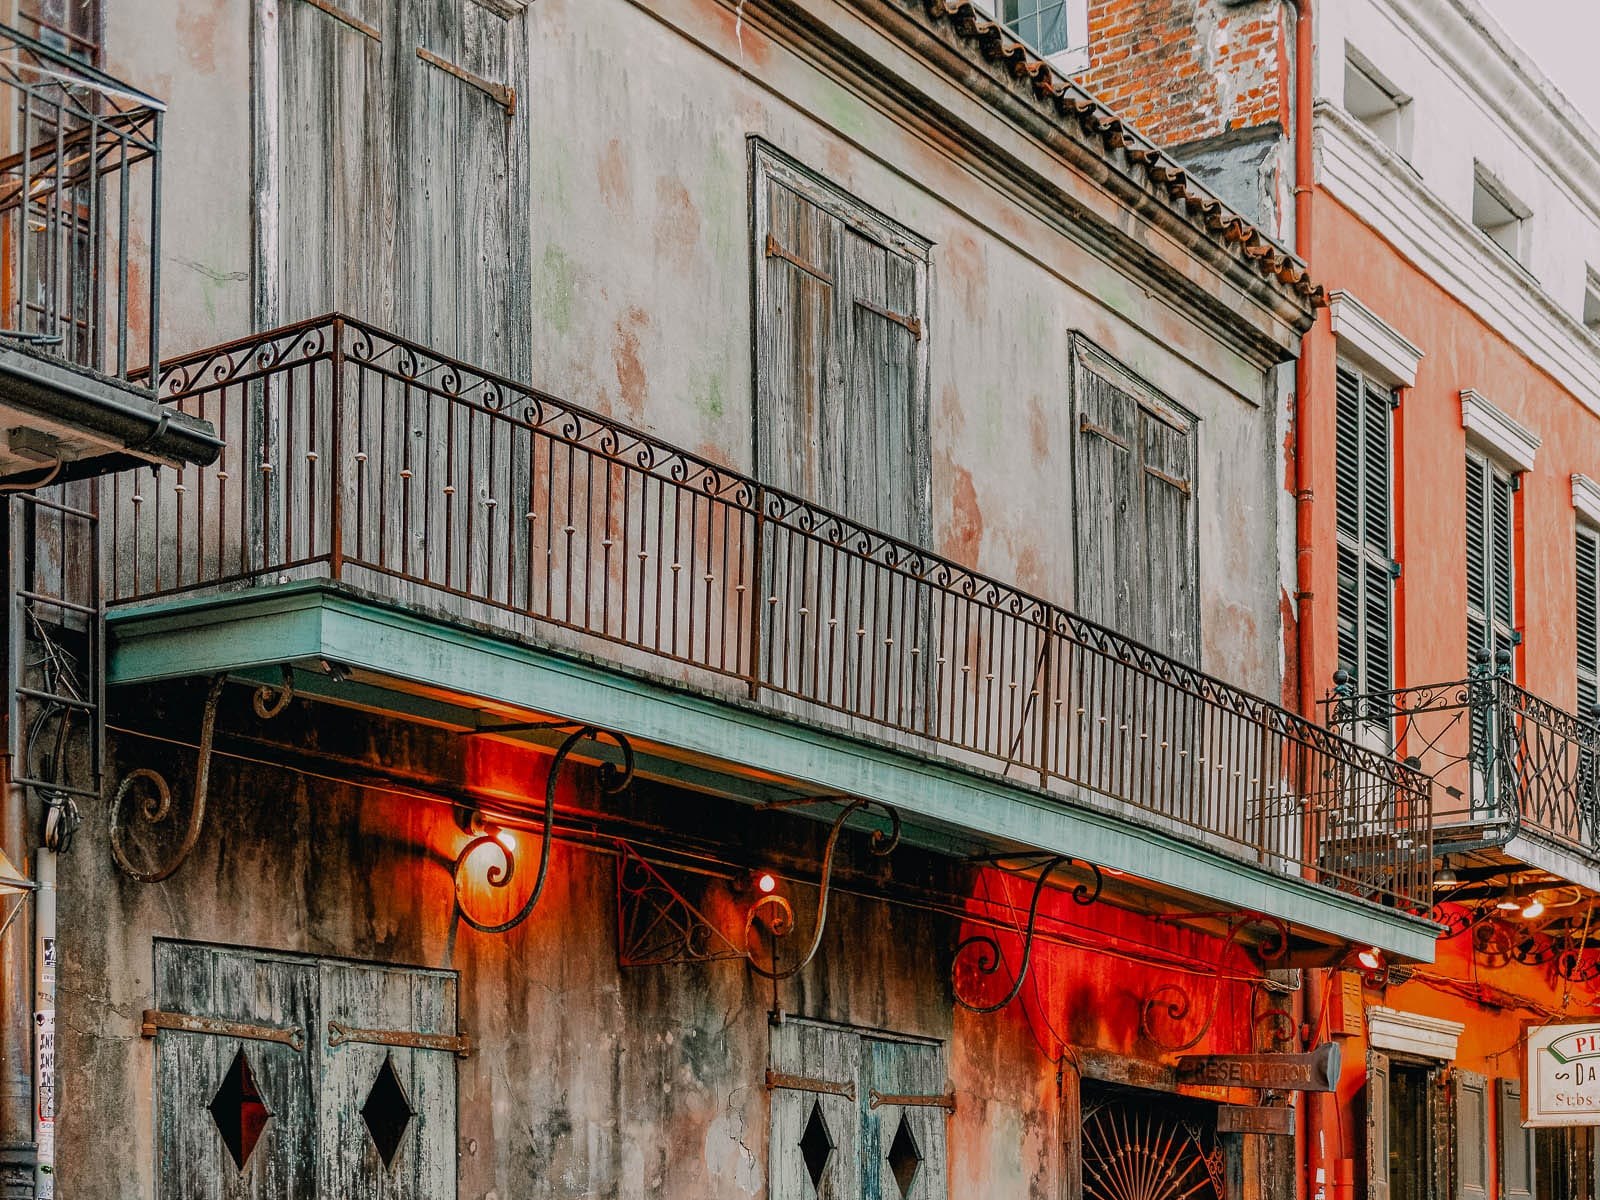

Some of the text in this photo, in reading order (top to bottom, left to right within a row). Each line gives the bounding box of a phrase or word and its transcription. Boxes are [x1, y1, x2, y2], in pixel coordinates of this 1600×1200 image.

[1576, 1034, 1600, 1053] PI
[1180, 1060, 1312, 1083] PRESERVATION
[1556, 1093, 1593, 1106] Subs
[1230, 1110, 1277, 1130] HALL
